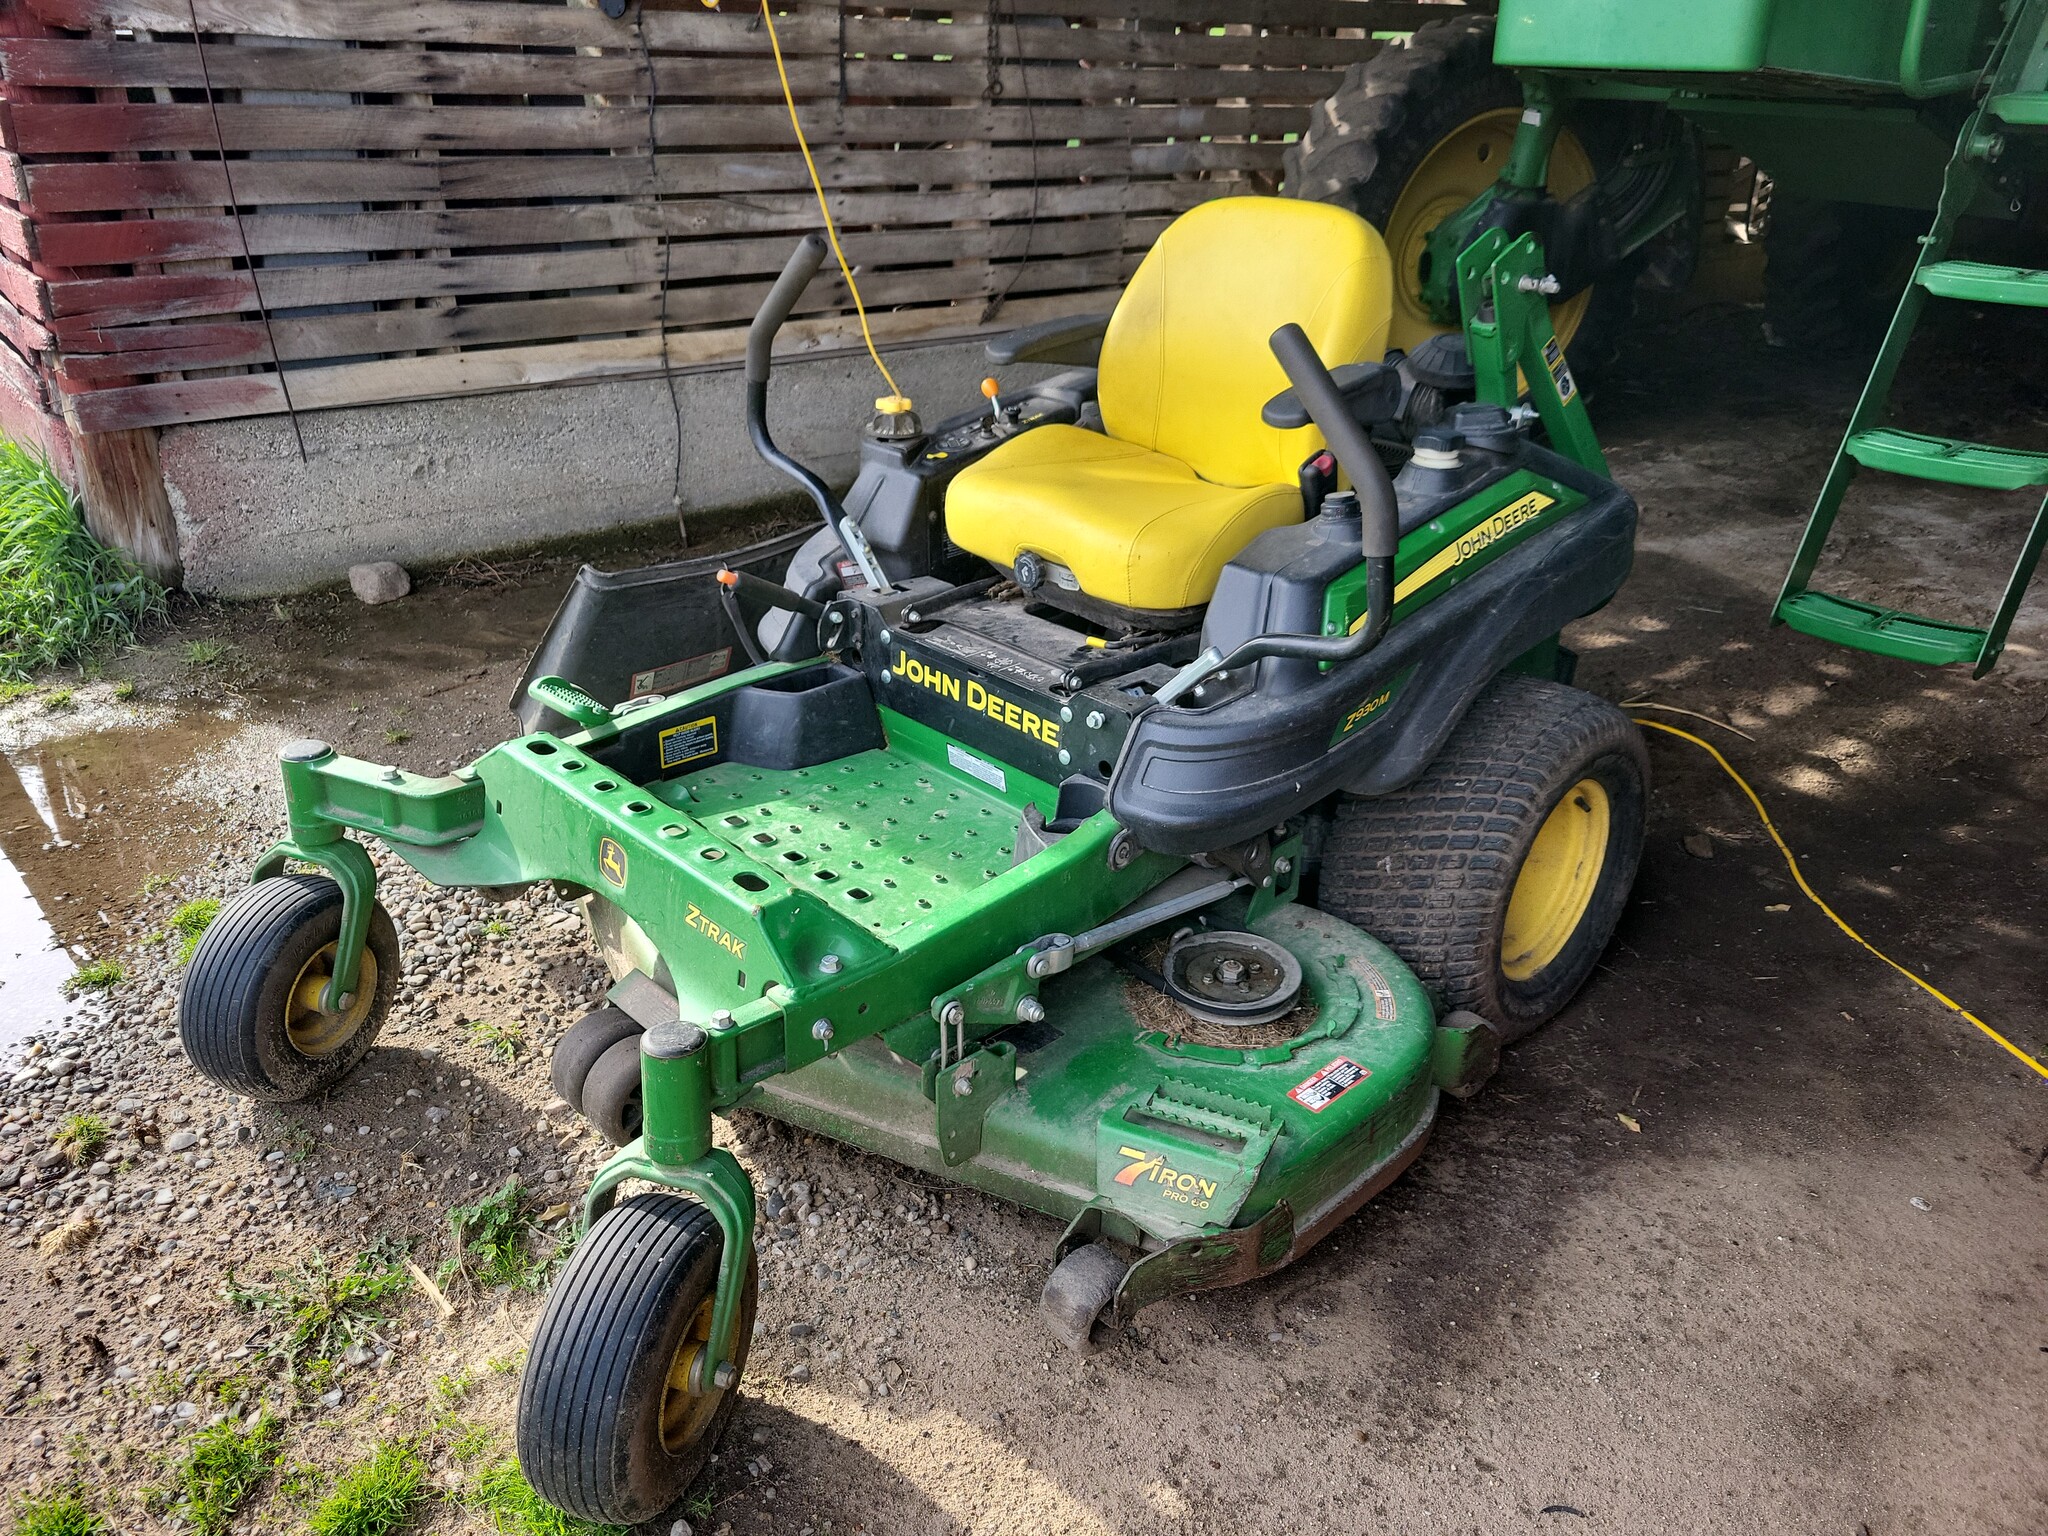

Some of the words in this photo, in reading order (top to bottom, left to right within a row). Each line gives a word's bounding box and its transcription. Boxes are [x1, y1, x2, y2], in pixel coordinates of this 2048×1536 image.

[1454, 526, 1493, 563] JOHN
[1492, 498, 1538, 537] DEERE
[892, 649, 961, 702] JOHN
[966, 679, 1061, 749] DEERE
[1343, 690, 1391, 733] Z930M
[684, 902, 747, 961] ZTRAK
[1113, 1146, 1160, 1187] 7
[1148, 1160, 1218, 1199] IRON
[1162, 1189, 1189, 1203] PRO
